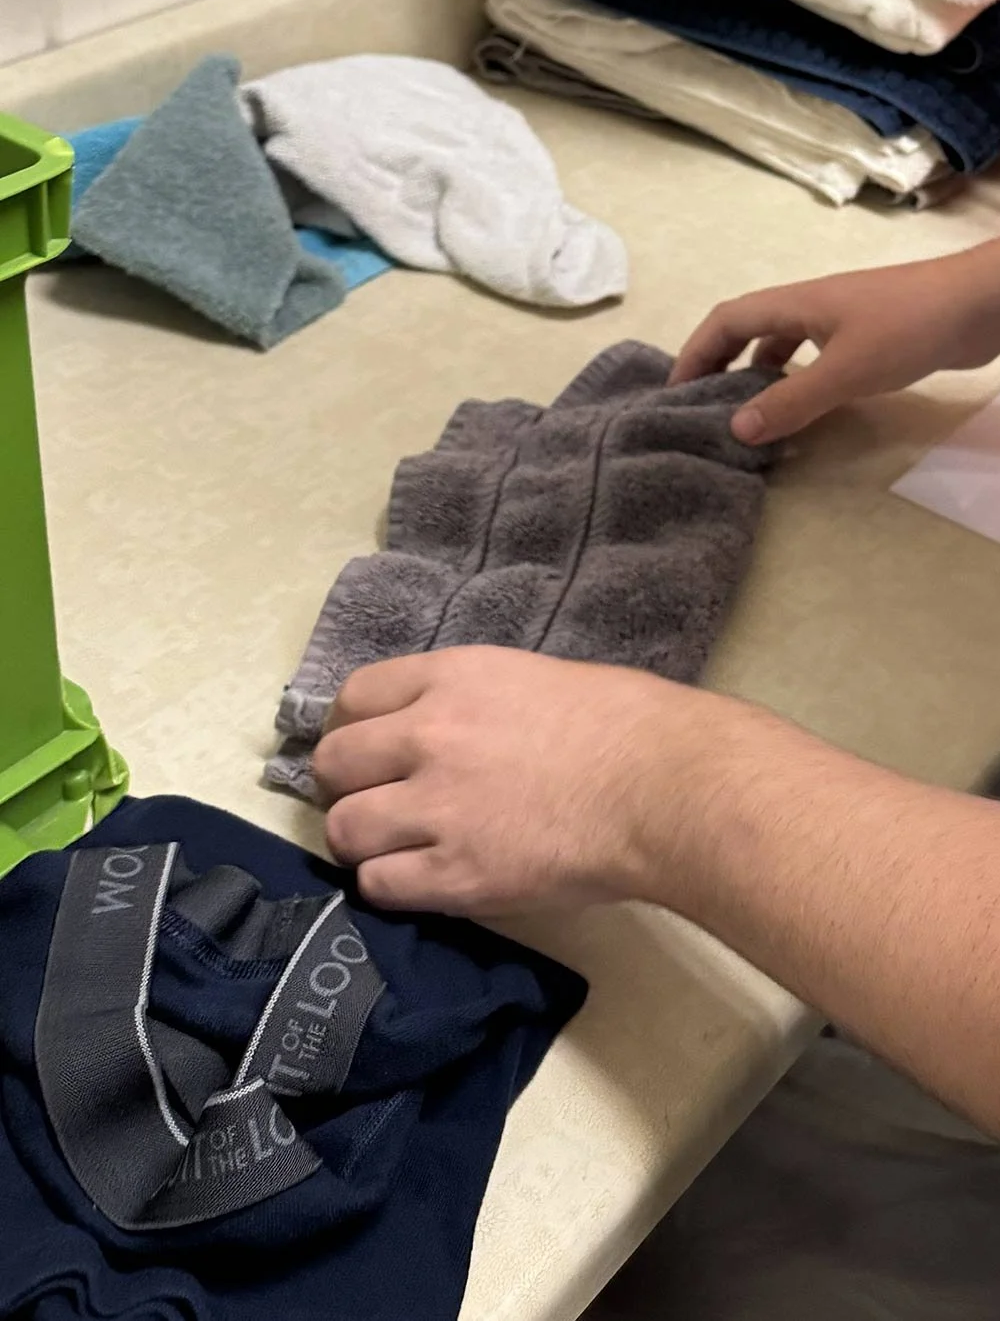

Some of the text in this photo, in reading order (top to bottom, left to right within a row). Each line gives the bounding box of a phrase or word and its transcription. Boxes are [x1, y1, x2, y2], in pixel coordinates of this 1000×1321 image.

[282, 1018, 304, 1052] OF
[298, 1022, 327, 1060] THE
[210, 1125, 237, 1149] OF
[208, 1148, 247, 1176] THE
